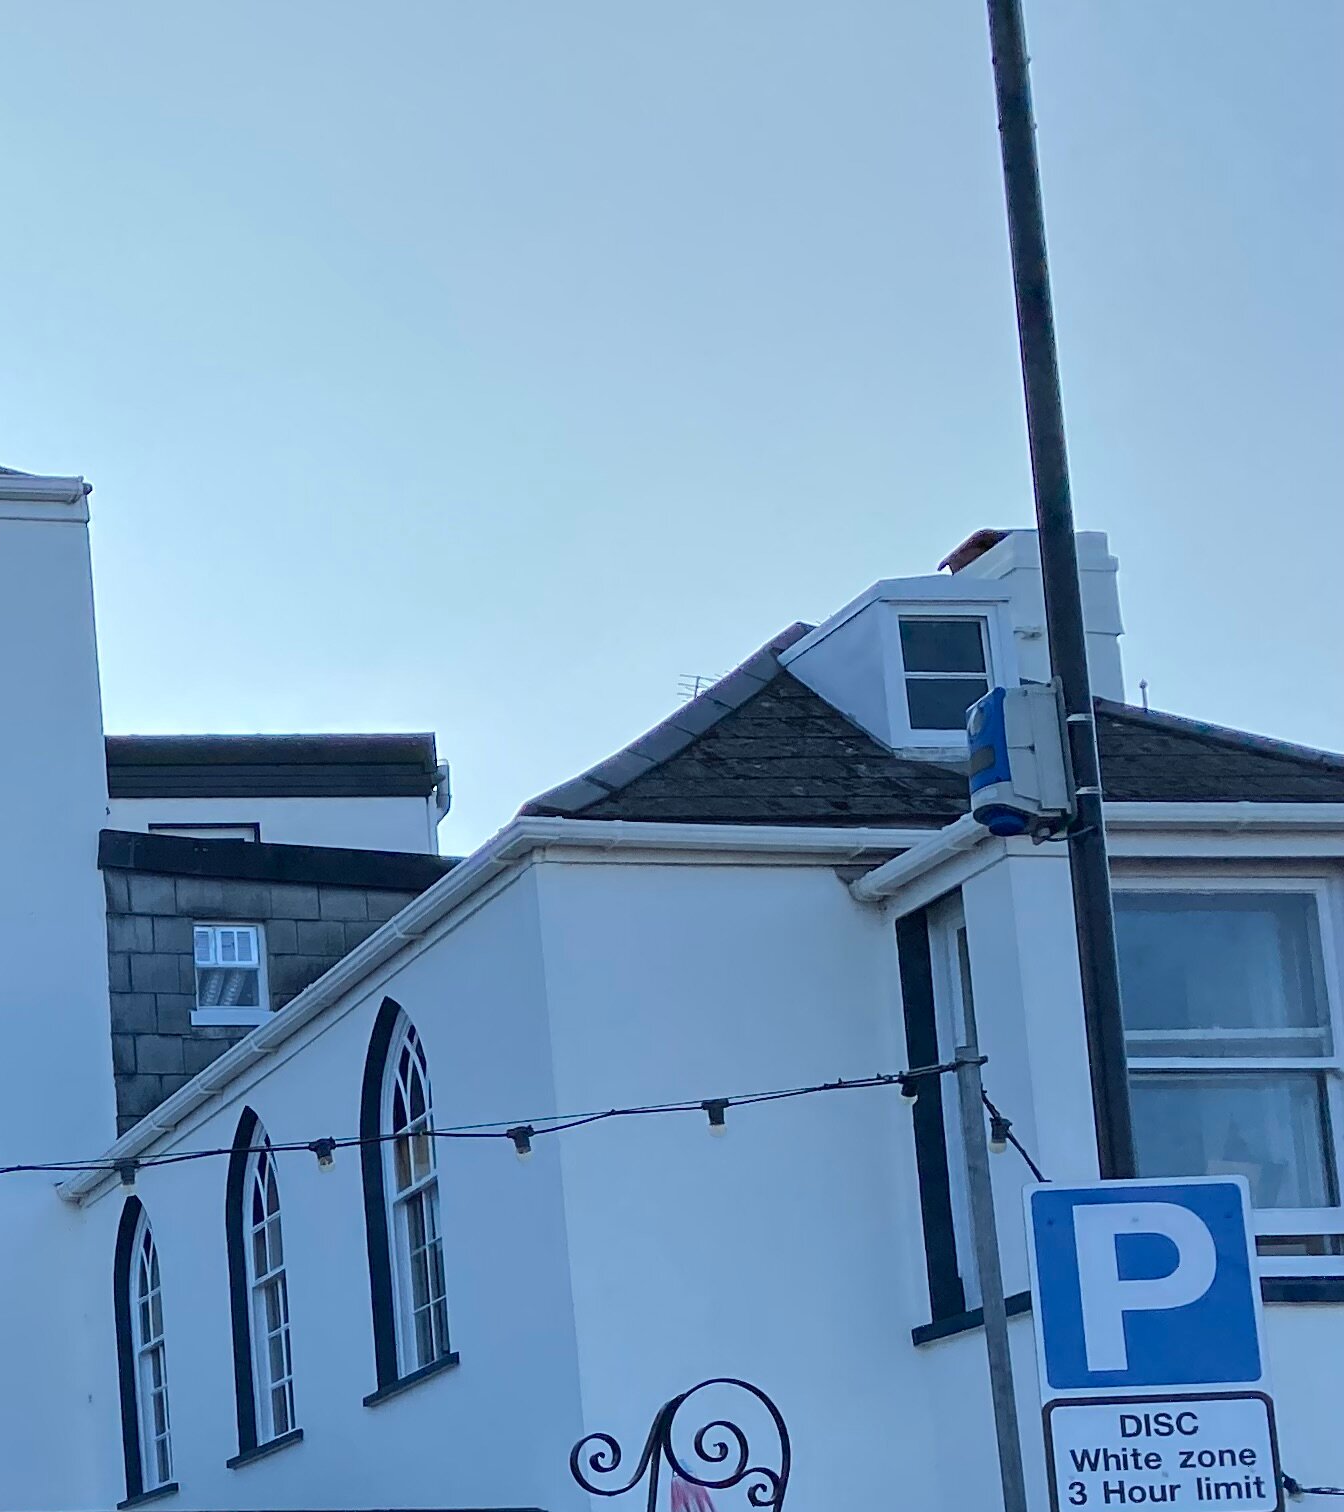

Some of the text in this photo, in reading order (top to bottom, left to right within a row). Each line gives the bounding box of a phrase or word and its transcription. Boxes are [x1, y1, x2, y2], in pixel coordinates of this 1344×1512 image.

[1072, 1202, 1218, 1372] P
[1119, 1411, 1199, 1438] DISC
[1070, 1448, 1256, 1472] White zone
[1068, 1476, 1266, 1505] 3 Hour limit
